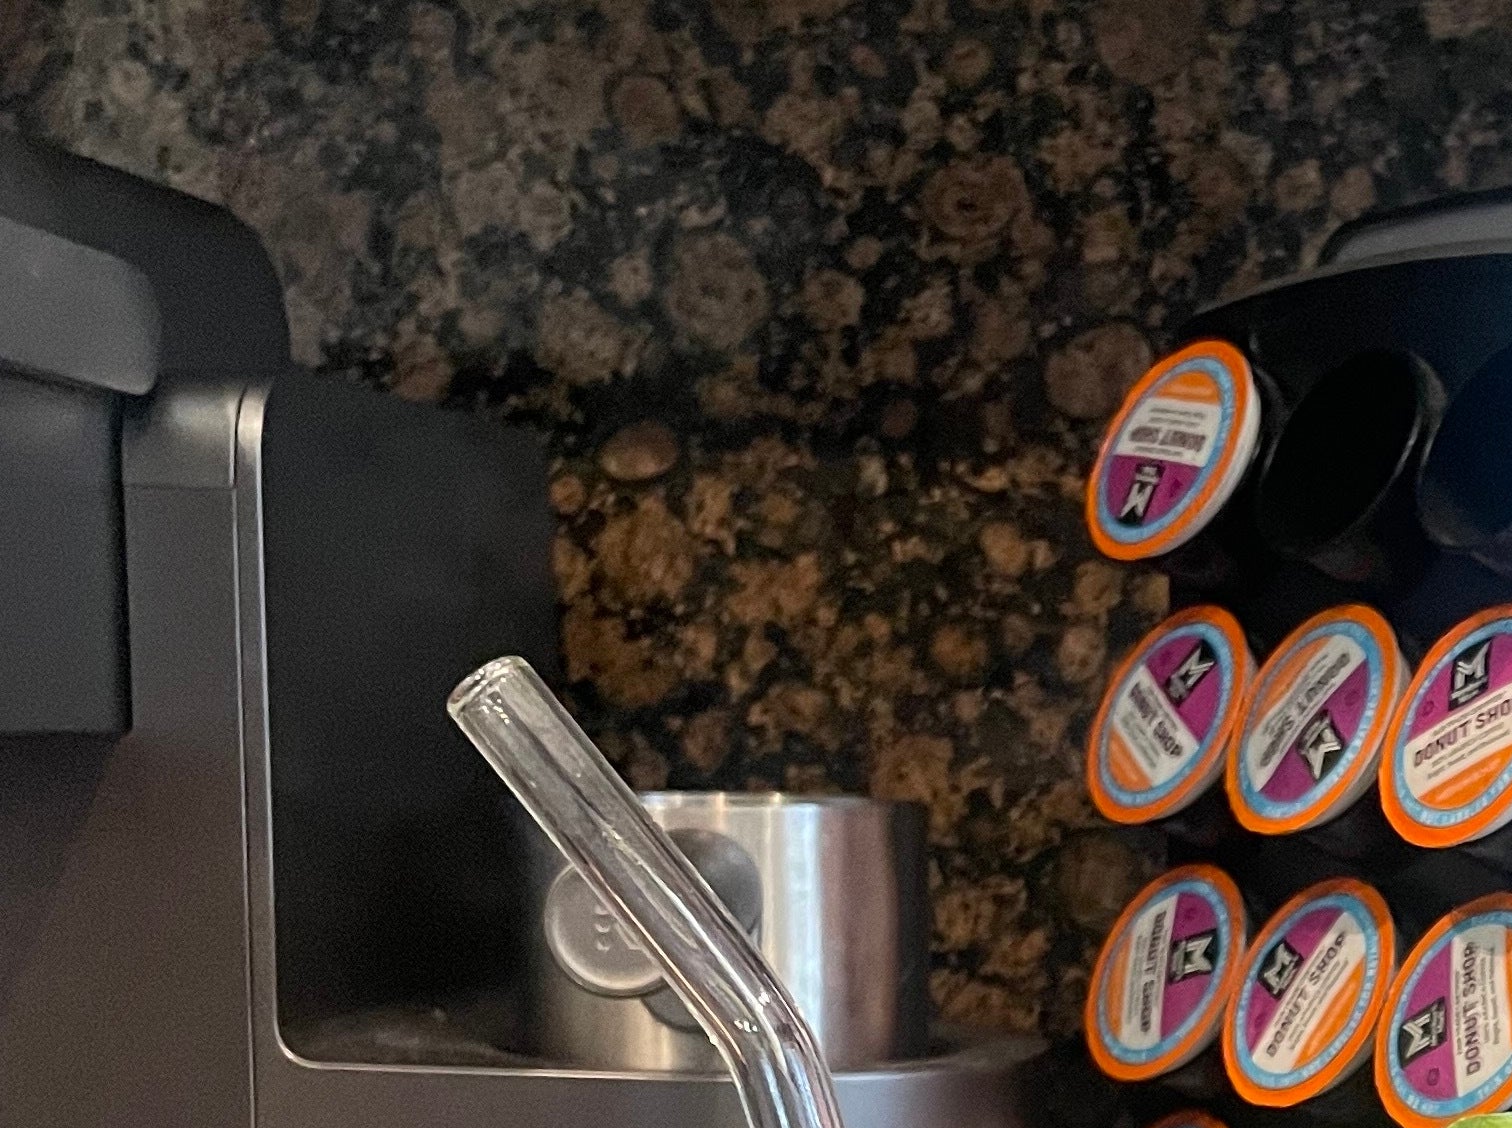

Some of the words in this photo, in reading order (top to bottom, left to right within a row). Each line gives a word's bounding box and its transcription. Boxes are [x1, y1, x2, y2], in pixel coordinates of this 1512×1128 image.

[1412, 720, 1474, 769] DONUT
[1264, 990, 1310, 1058] DONUT
[1309, 930, 1347, 986] SHOP
[1461, 940, 1480, 998] SHOP
[1462, 999, 1482, 1077] DONUT
